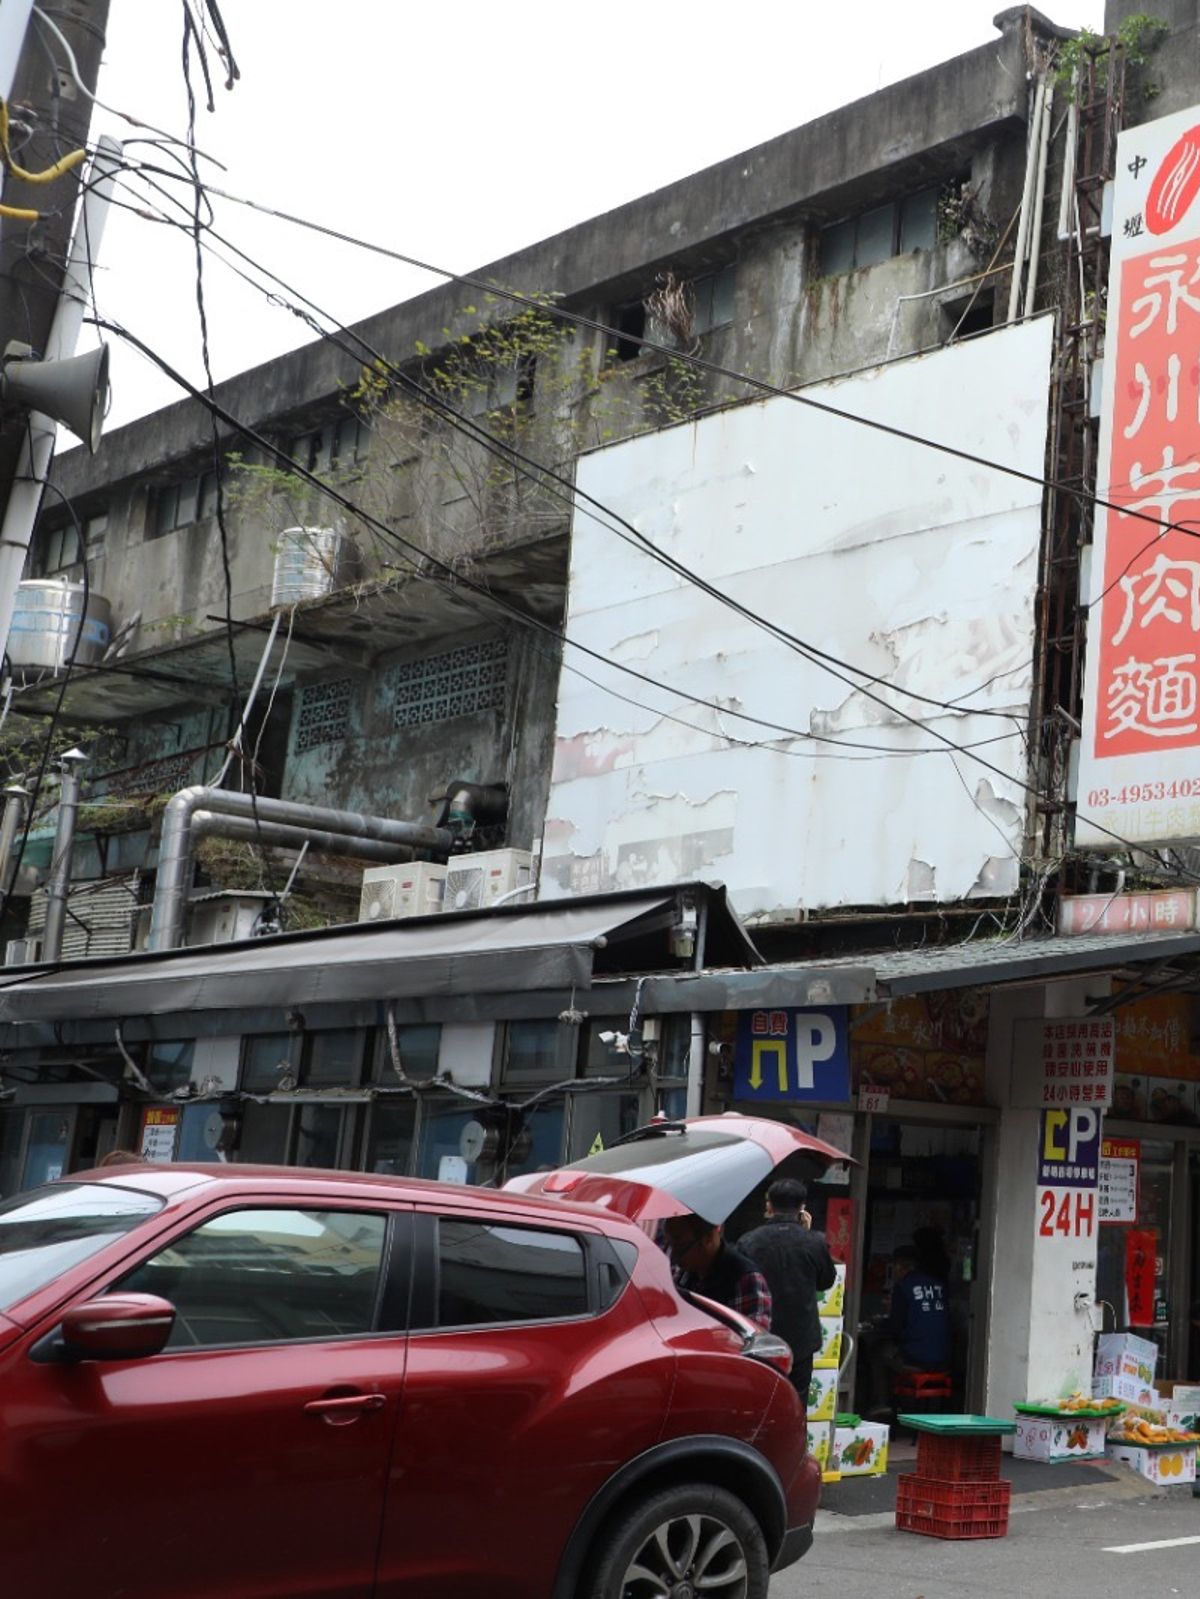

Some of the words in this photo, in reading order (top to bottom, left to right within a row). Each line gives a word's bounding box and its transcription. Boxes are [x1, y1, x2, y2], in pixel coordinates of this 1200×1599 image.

[796, 1013, 837, 1089] P
[1067, 1107, 1098, 1163] P
[1038, 1190, 1095, 1238] 24H
